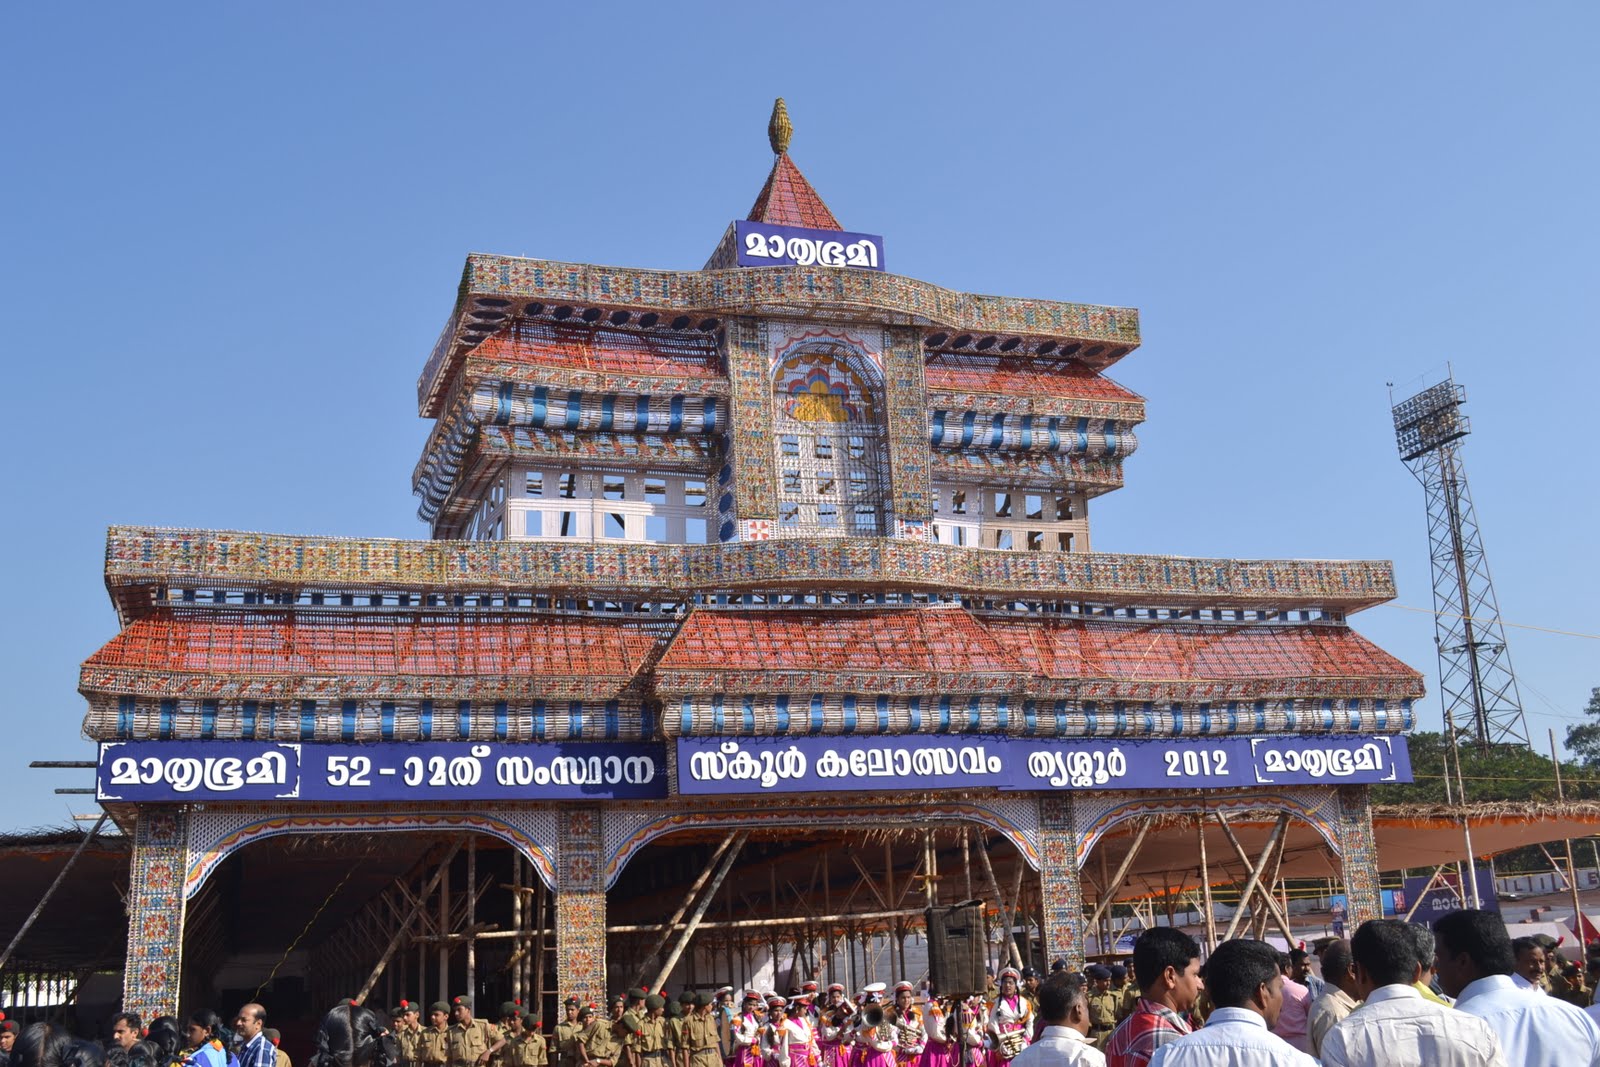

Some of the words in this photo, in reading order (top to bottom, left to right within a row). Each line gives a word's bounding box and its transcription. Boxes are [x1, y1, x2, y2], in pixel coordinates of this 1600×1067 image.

[745, 232, 878, 268] മാതൃഭൂമി
[110, 750, 288, 792] മാതൃഭൂമി
[496, 754, 655, 786] സംസ്ഥാന
[690, 741, 807, 788] സ്കൂൾ
[816, 746, 1003, 778] കലോത്സവം
[1164, 749, 1230, 777] 2012
[1264, 742, 1383, 778] മാതൃഭൂമി
